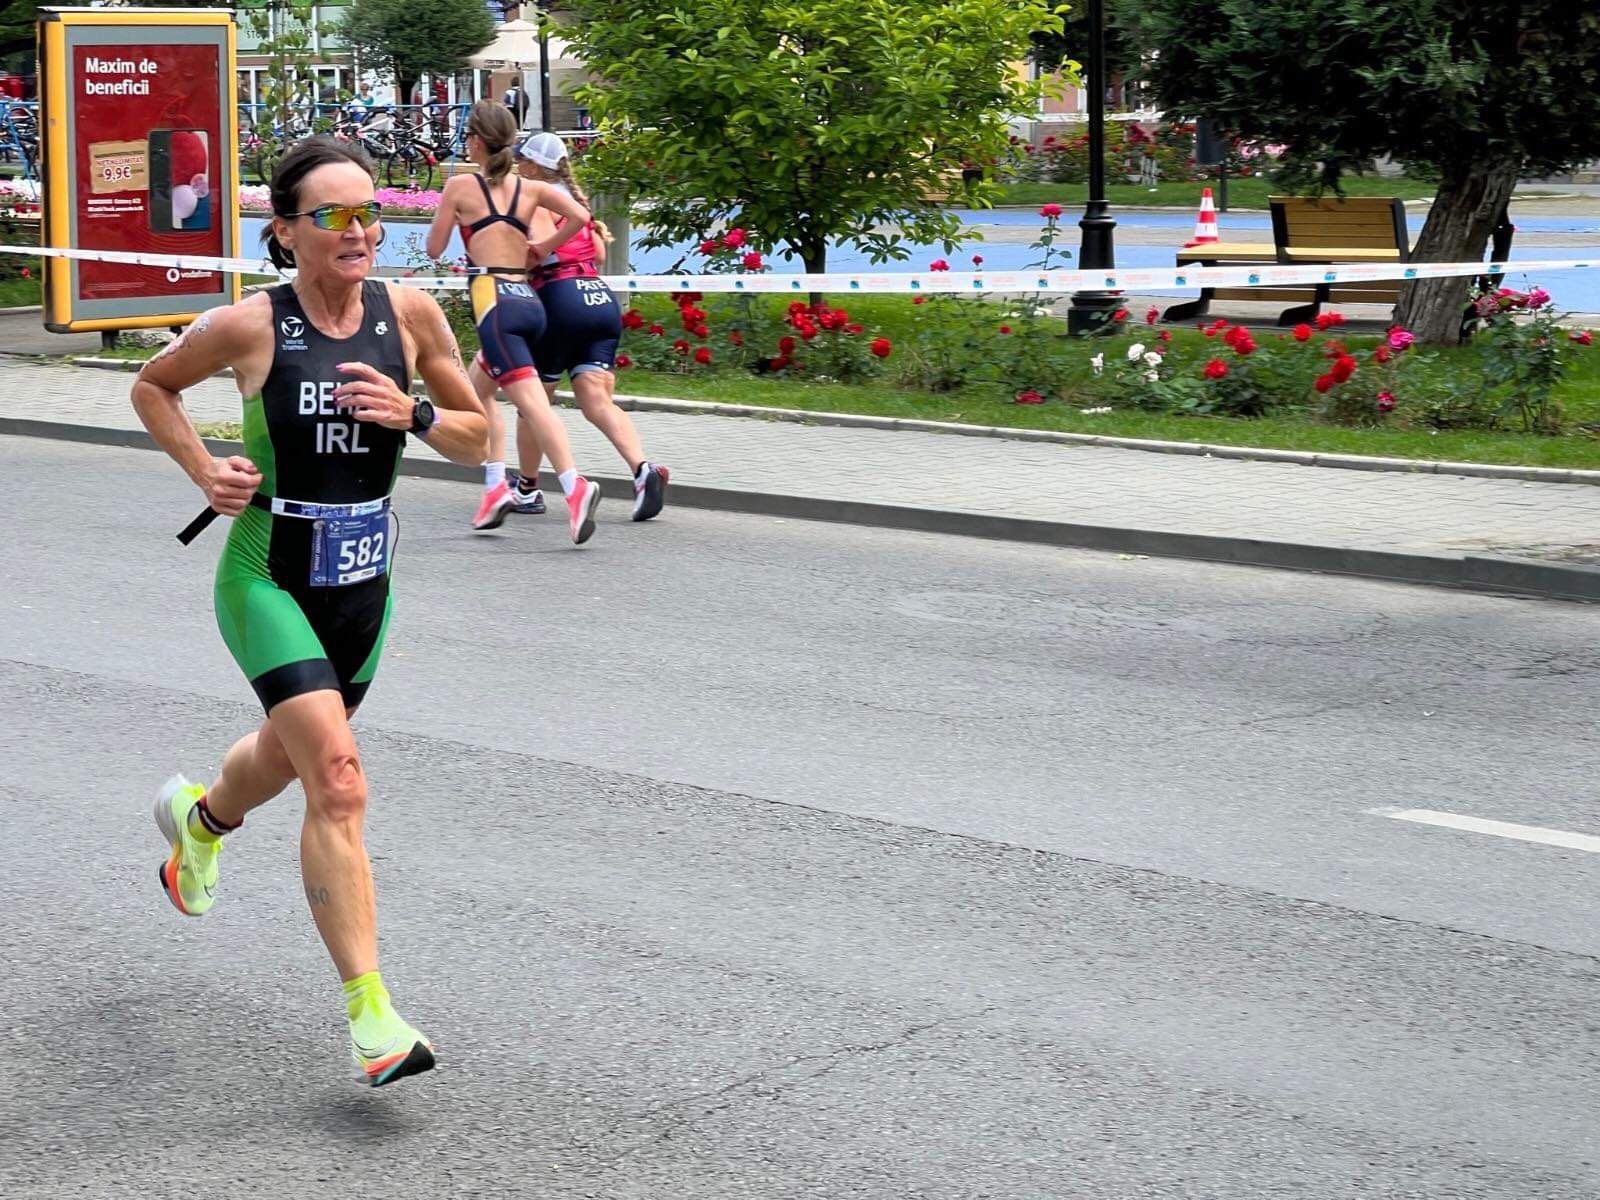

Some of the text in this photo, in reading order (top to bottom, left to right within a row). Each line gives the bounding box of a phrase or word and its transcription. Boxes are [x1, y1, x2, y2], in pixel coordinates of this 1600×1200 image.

[85, 57, 157, 73] Maxim de
[85, 79, 149, 95] beneficii
[583, 291, 613, 305] USA
[316, 423, 370, 453] IRL
[337, 532, 384, 571] 582
